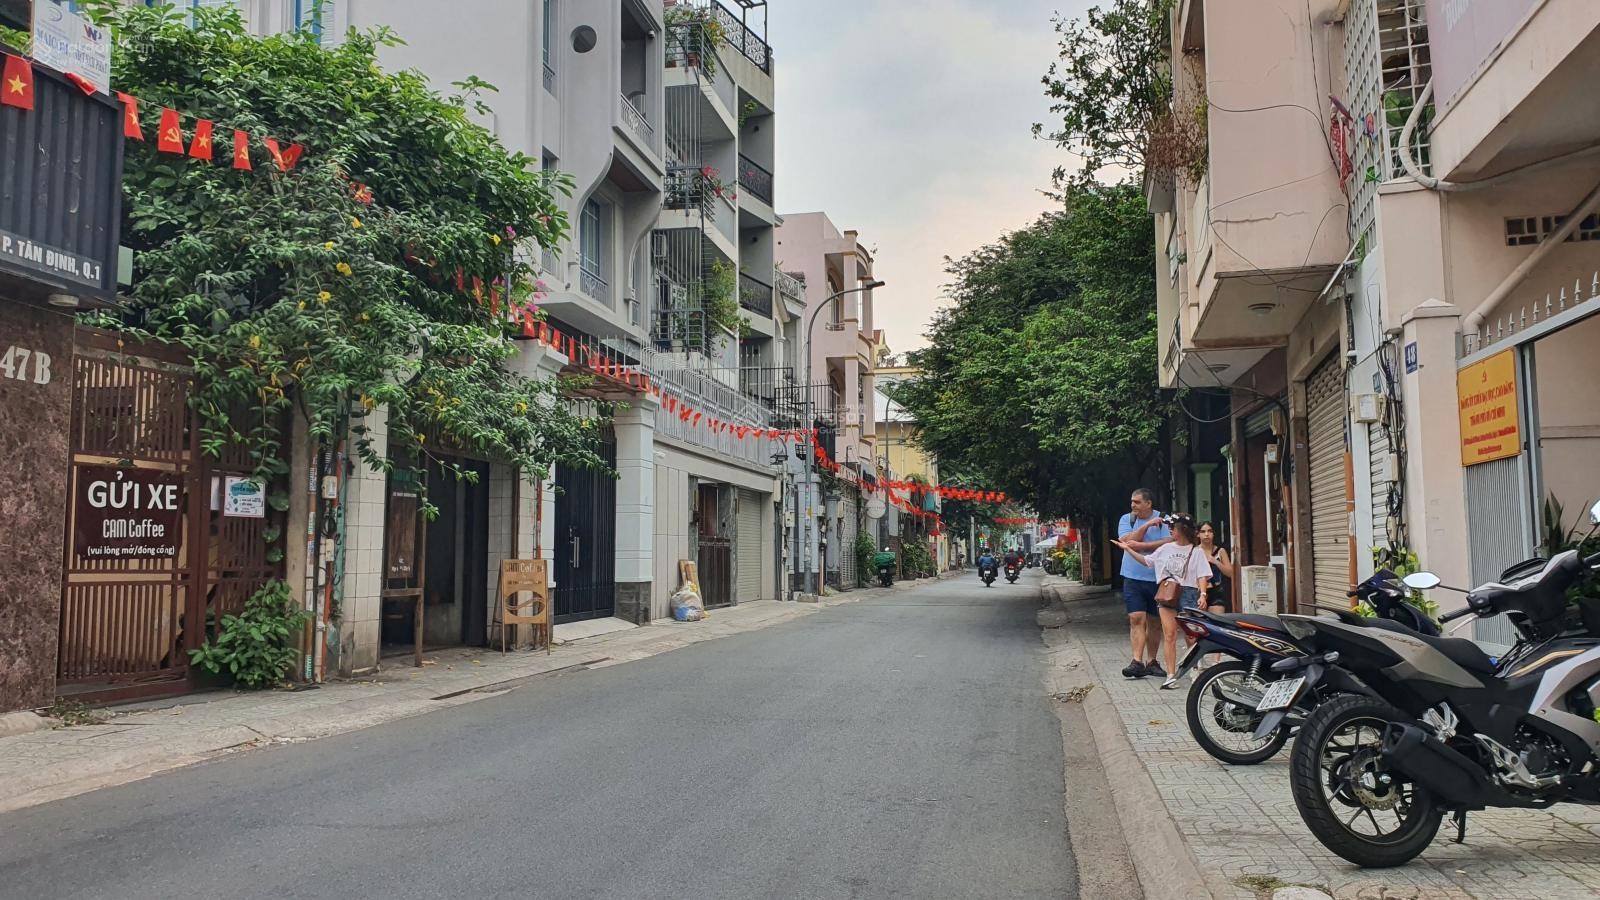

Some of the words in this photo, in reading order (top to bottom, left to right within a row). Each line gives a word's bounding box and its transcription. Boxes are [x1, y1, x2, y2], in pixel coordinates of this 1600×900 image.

[2, 235, 14, 254] P.
[17, 240, 43, 263] TÂN
[46, 249, 80, 276] ĐỊNH,
[82, 261, 100, 280] Q.1
[87, 470, 140, 509] GỬI
[147, 483, 178, 510] XE
[102, 518, 127, 538] CAM
[128, 518, 165, 537] Coffee
[87, 545, 103, 556] (vui
[103, 545, 120, 556] lòng
